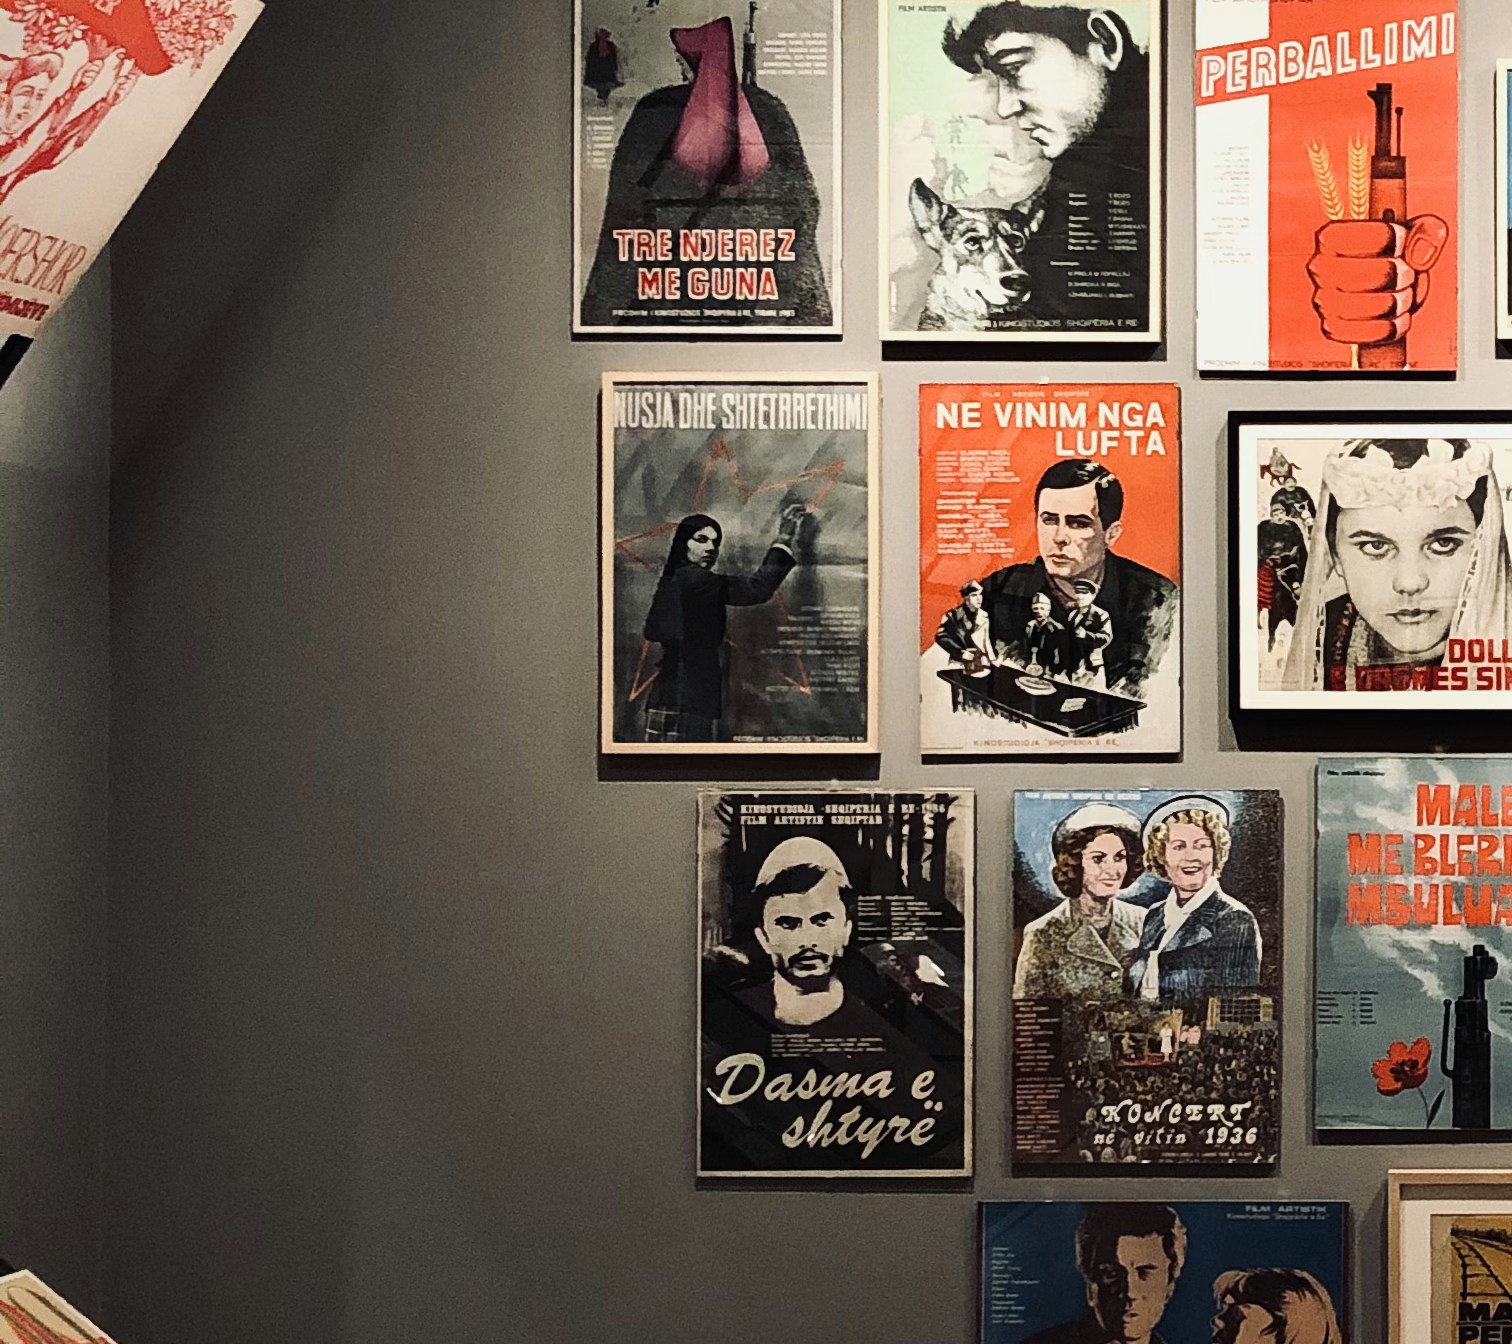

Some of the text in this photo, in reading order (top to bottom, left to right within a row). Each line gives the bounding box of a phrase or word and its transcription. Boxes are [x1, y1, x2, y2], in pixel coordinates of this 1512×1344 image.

[1200, 12, 1455, 97] PERBALLIMI
[613, 229, 796, 262] TRE NJEREZ
[638, 267, 779, 301] ME GUNA
[614, 392, 674, 429] NUSJA
[679, 392, 717, 429] DHE
[937, 402, 1166, 428] NE VINIM NGA
[1055, 430, 1166, 456] LUFTA
[740, 815, 767, 824] FILM
[1347, 833, 1403, 875] ME
[706, 1053, 935, 1105] Dasma e
[781, 1099, 943, 1159] shtyrë
[1101, 1098, 1251, 1127] KONCERT
[1134, 1128, 1187, 1144] vitin
[1205, 1127, 1257, 1144] 1936
